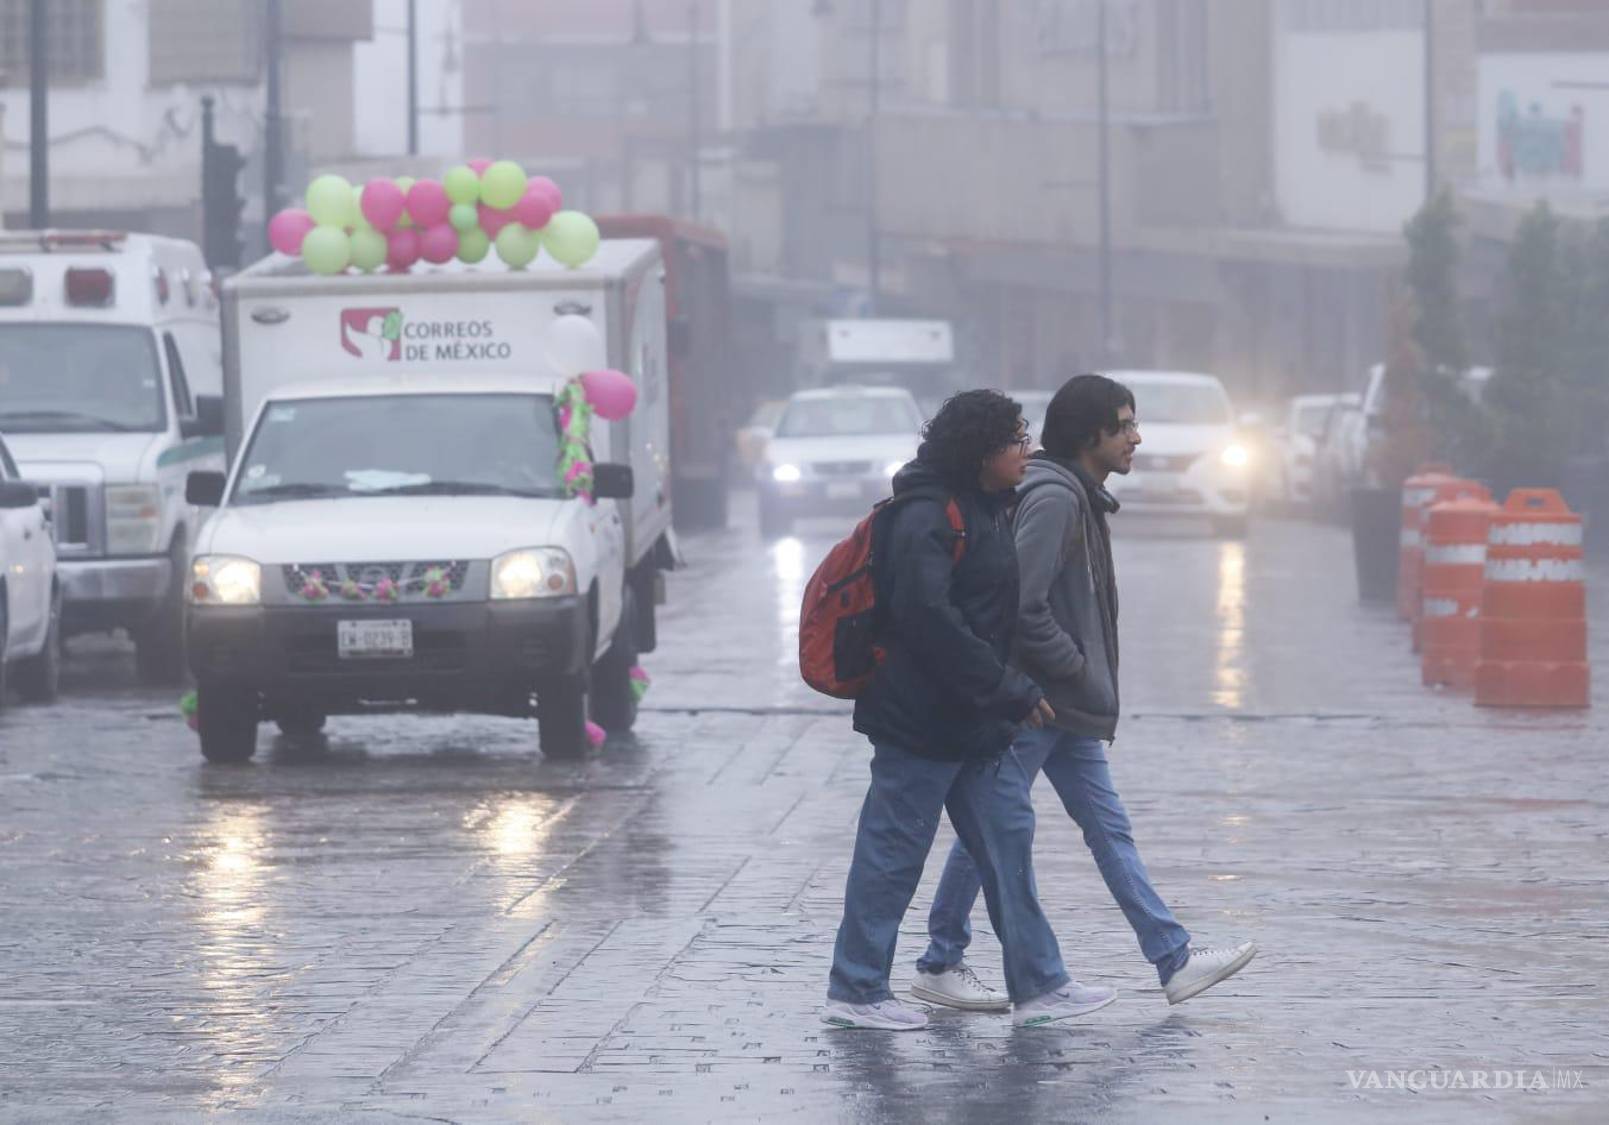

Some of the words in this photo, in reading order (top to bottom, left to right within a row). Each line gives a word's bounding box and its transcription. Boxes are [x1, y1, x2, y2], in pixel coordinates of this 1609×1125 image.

[404, 321, 493, 339] CORREOS
[405, 345, 428, 361] DE
[435, 340, 511, 361] MÉXICO
